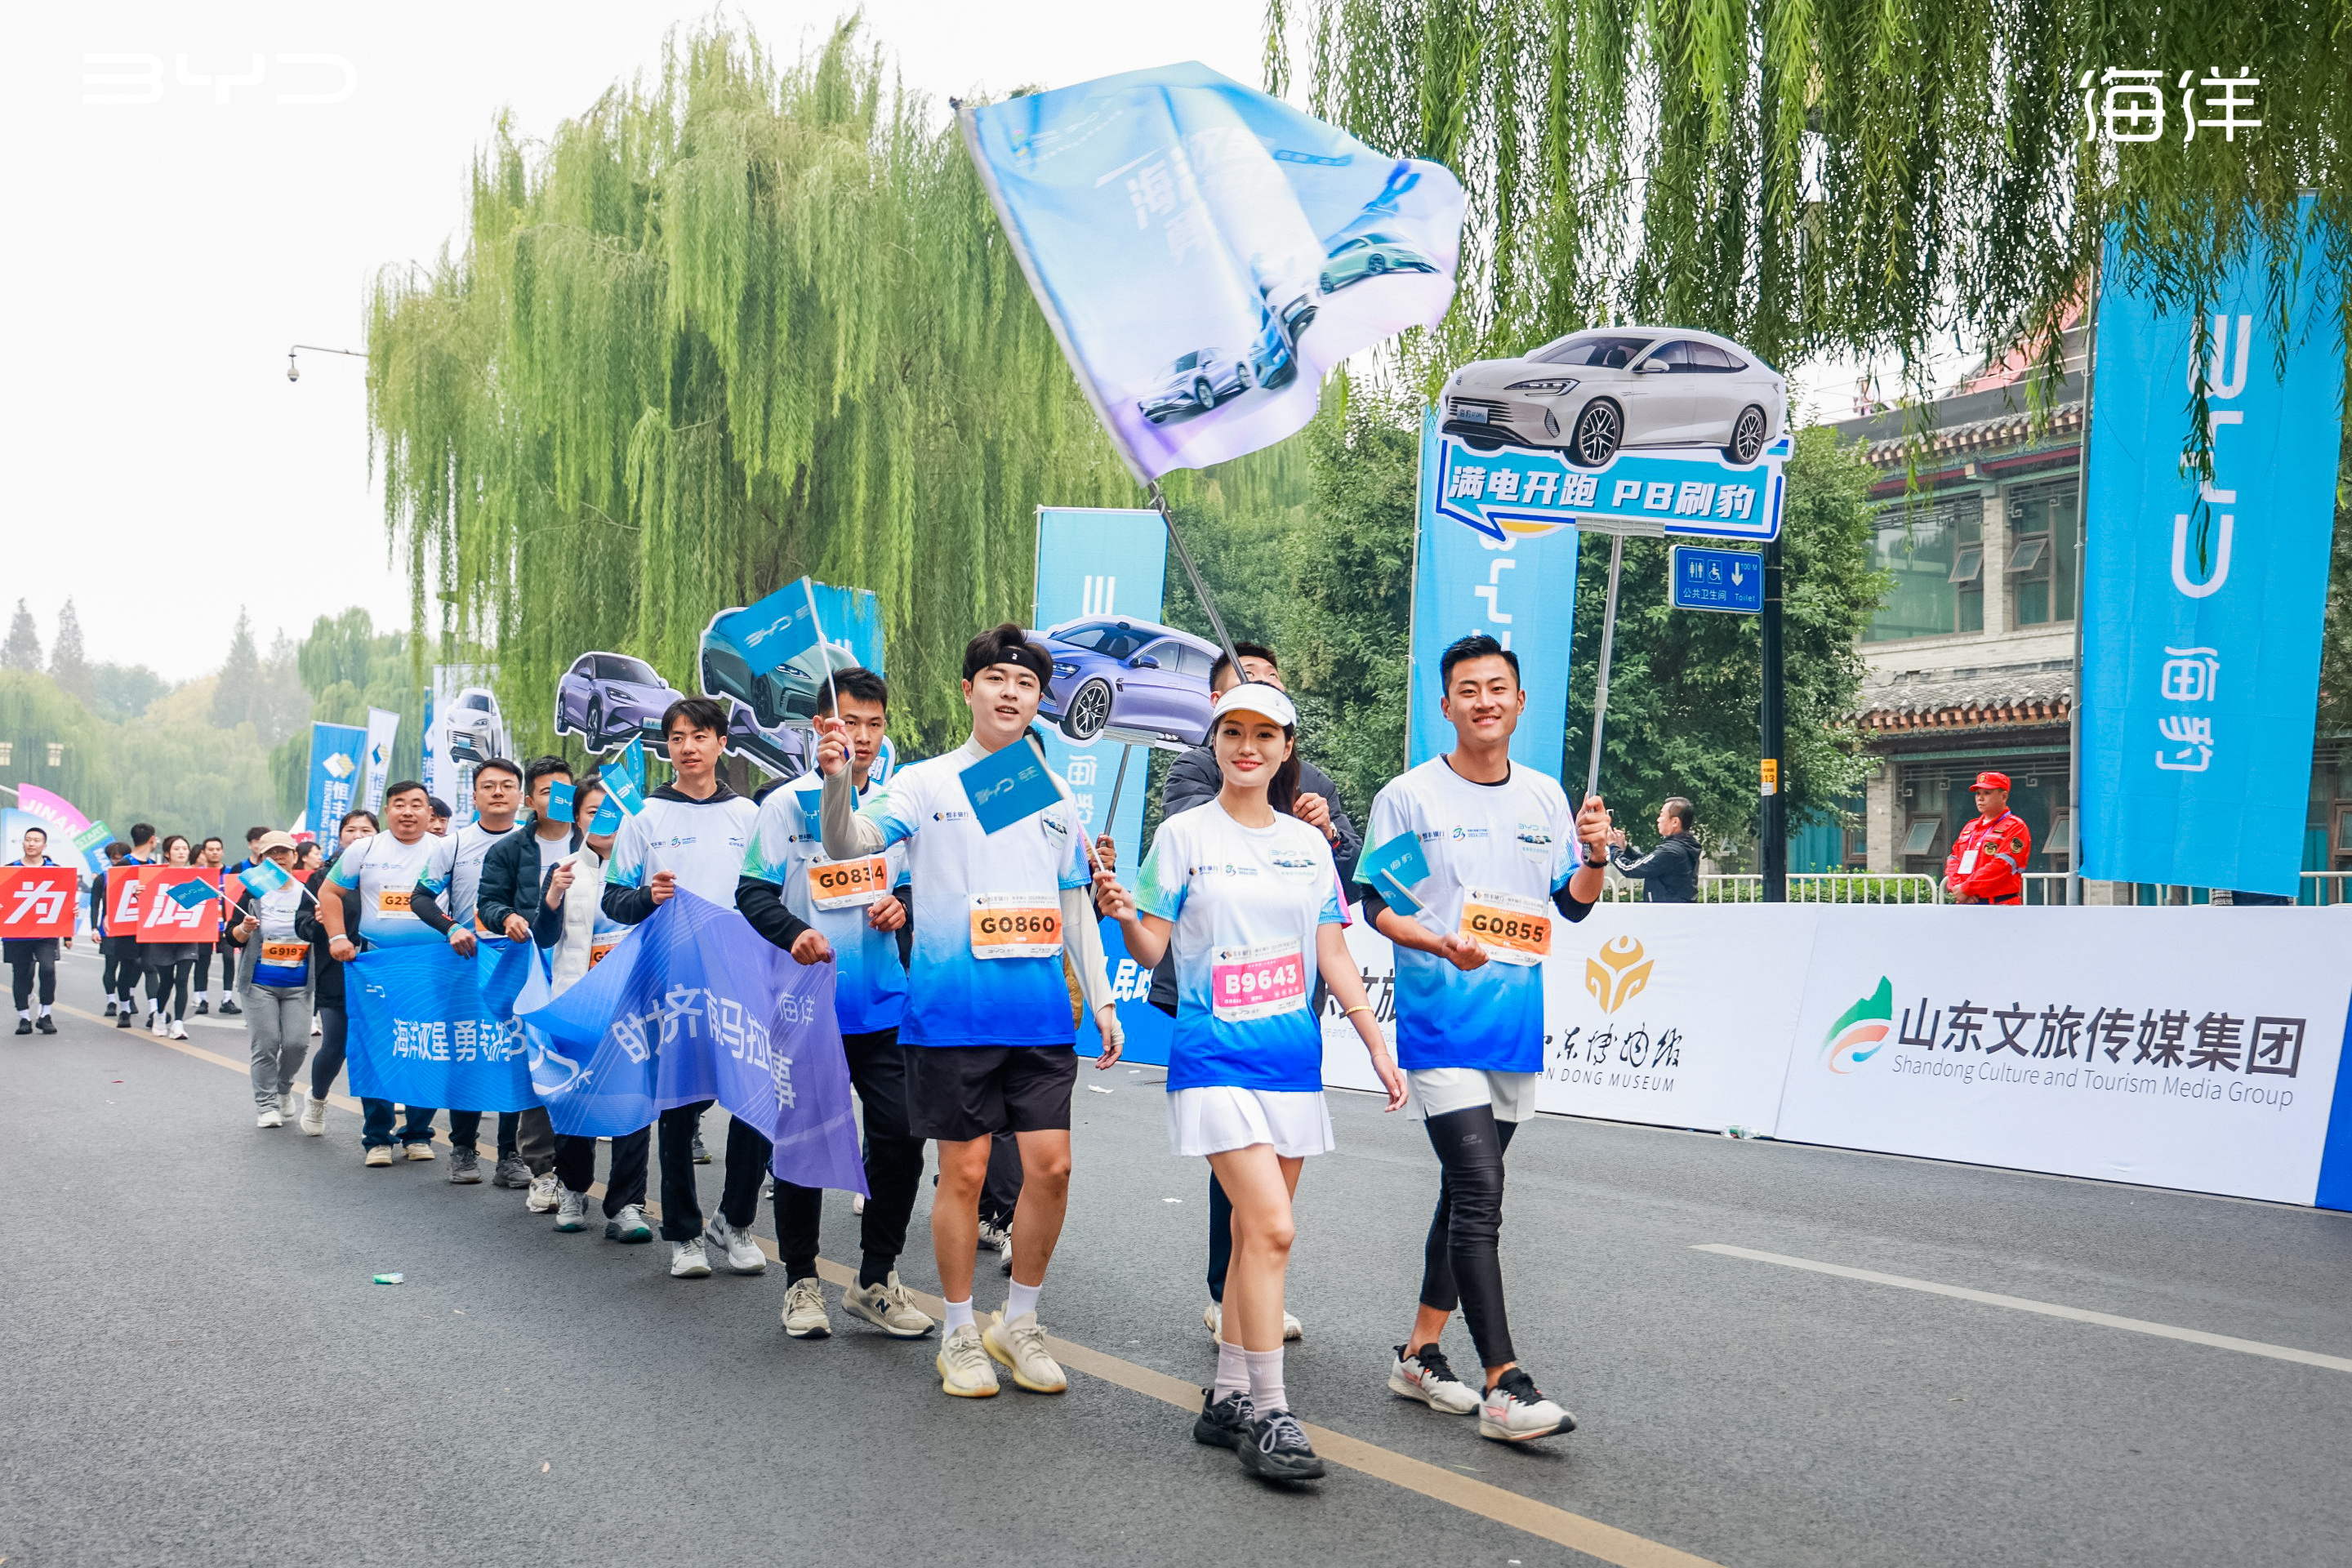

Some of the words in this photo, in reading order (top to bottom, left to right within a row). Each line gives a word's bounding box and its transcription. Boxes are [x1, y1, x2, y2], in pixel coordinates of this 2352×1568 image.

[1448, 466, 1599, 508] 满电开跑
[1612, 480, 1757, 520] PB刷豹
[1683, 587, 1727, 602] 公共卫生间
[1734, 593, 1756, 603] Toilet
[2154, 645, 2220, 772] 海豹
[819, 865, 884, 889] G0834
[4, 880, 67, 924] 为
[385, 895, 411, 906] G23
[981, 916, 1055, 933] G0860
[1472, 913, 1544, 942] G0855
[1226, 963, 1298, 995] B9643
[1544, 1022, 1683, 1069] 东博物馆
[1898, 996, 2307, 1079] 山东文旅传媒集团
[1561, 1068, 1604, 1086] DONG
[1609, 1072, 1675, 1093] MUSEUM
[1892, 1054, 1975, 1084] Shandong
[1978, 1062, 2040, 1085] Culture
[2043, 1068, 2078, 1088] and
[2084, 1070, 2157, 1095] Tourism
[2162, 1076, 2222, 1101] Media
[2228, 1081, 2295, 1112] Group
